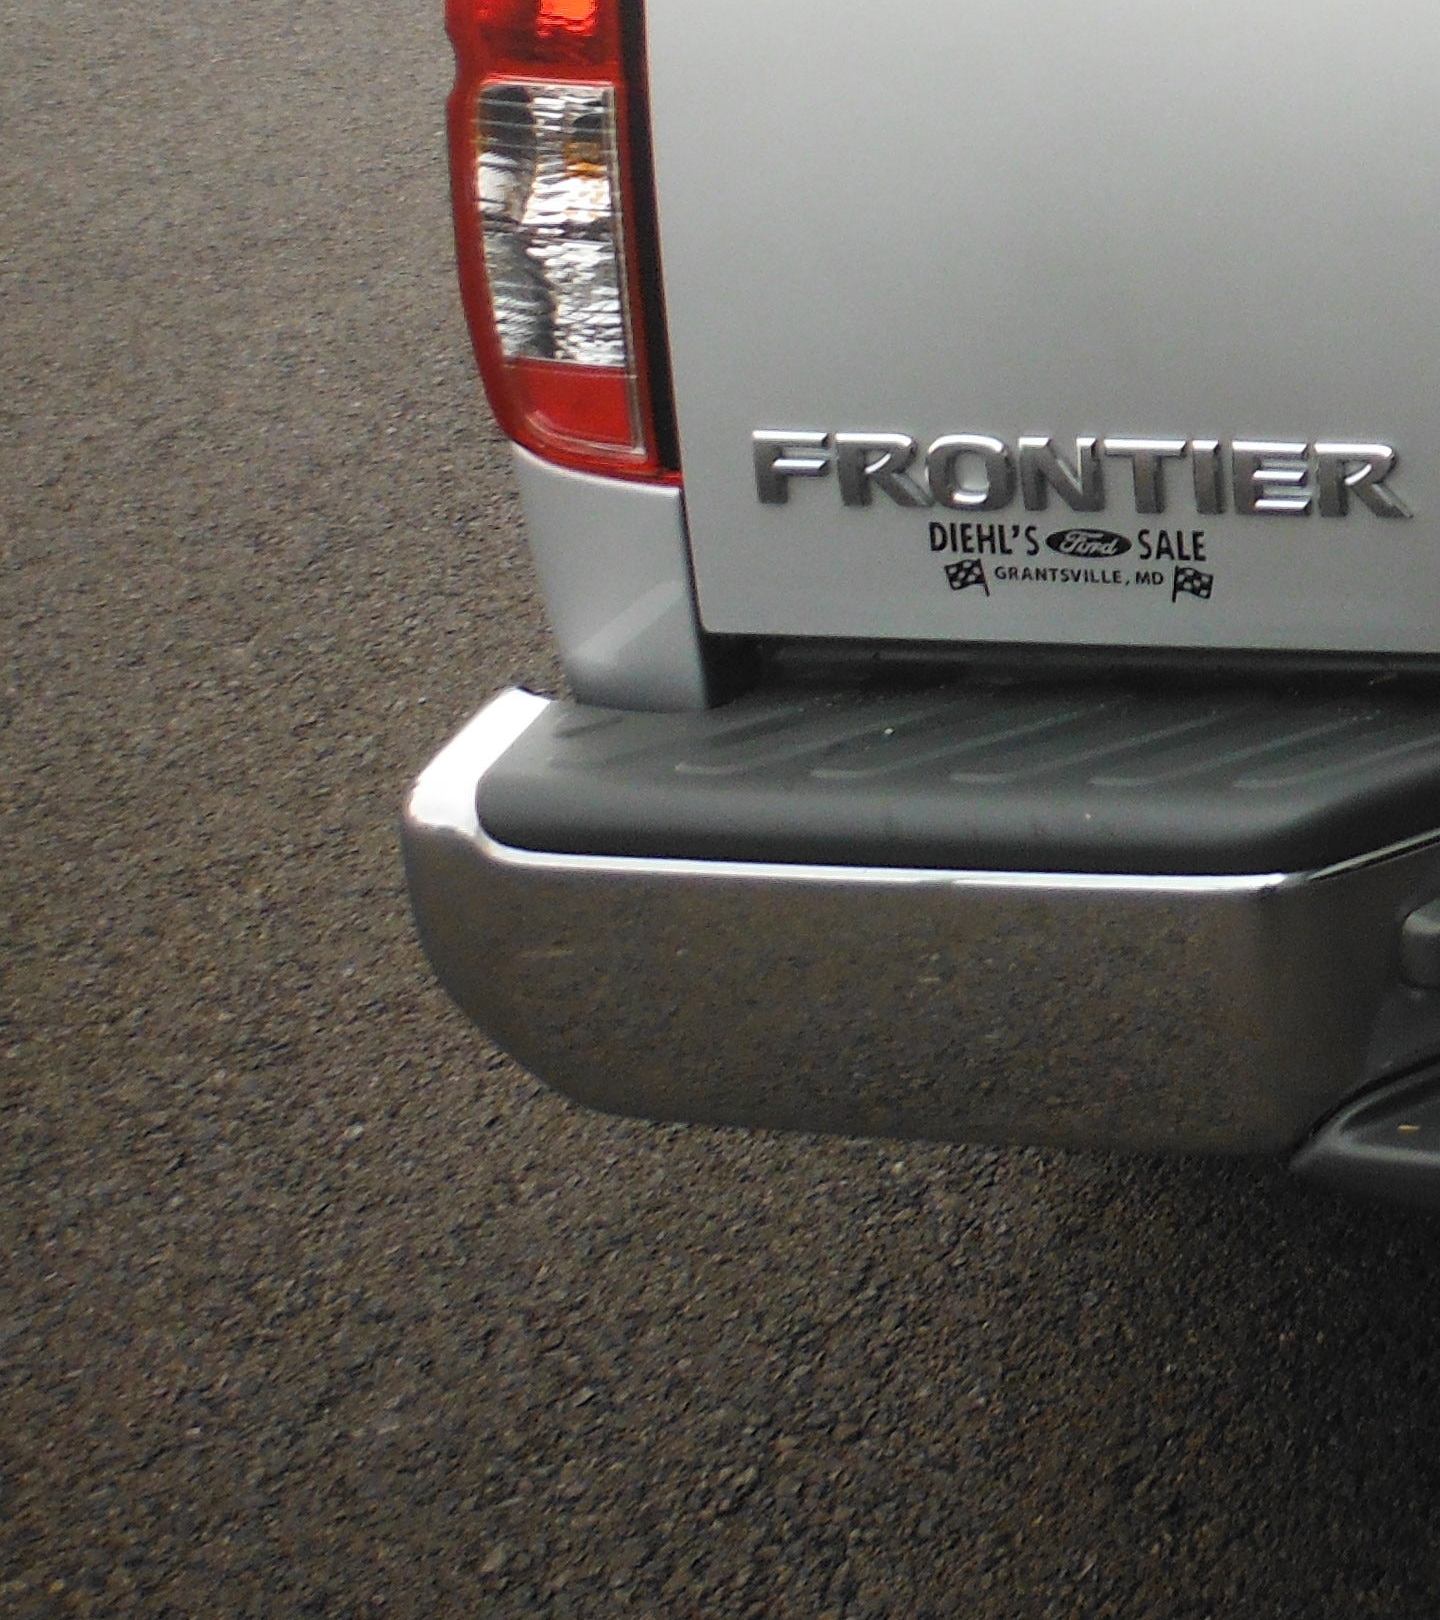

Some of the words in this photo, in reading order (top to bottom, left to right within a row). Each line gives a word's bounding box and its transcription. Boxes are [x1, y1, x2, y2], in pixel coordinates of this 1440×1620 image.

[752, 429, 1413, 520] FRONTIER
[929, 521, 1040, 556] DIEHL'S
[1060, 530, 1119, 557] Ford
[1137, 529, 1207, 562] SALE
[993, 565, 1130, 586] GRANTSVILLE,
[1135, 570, 1165, 586] MD
